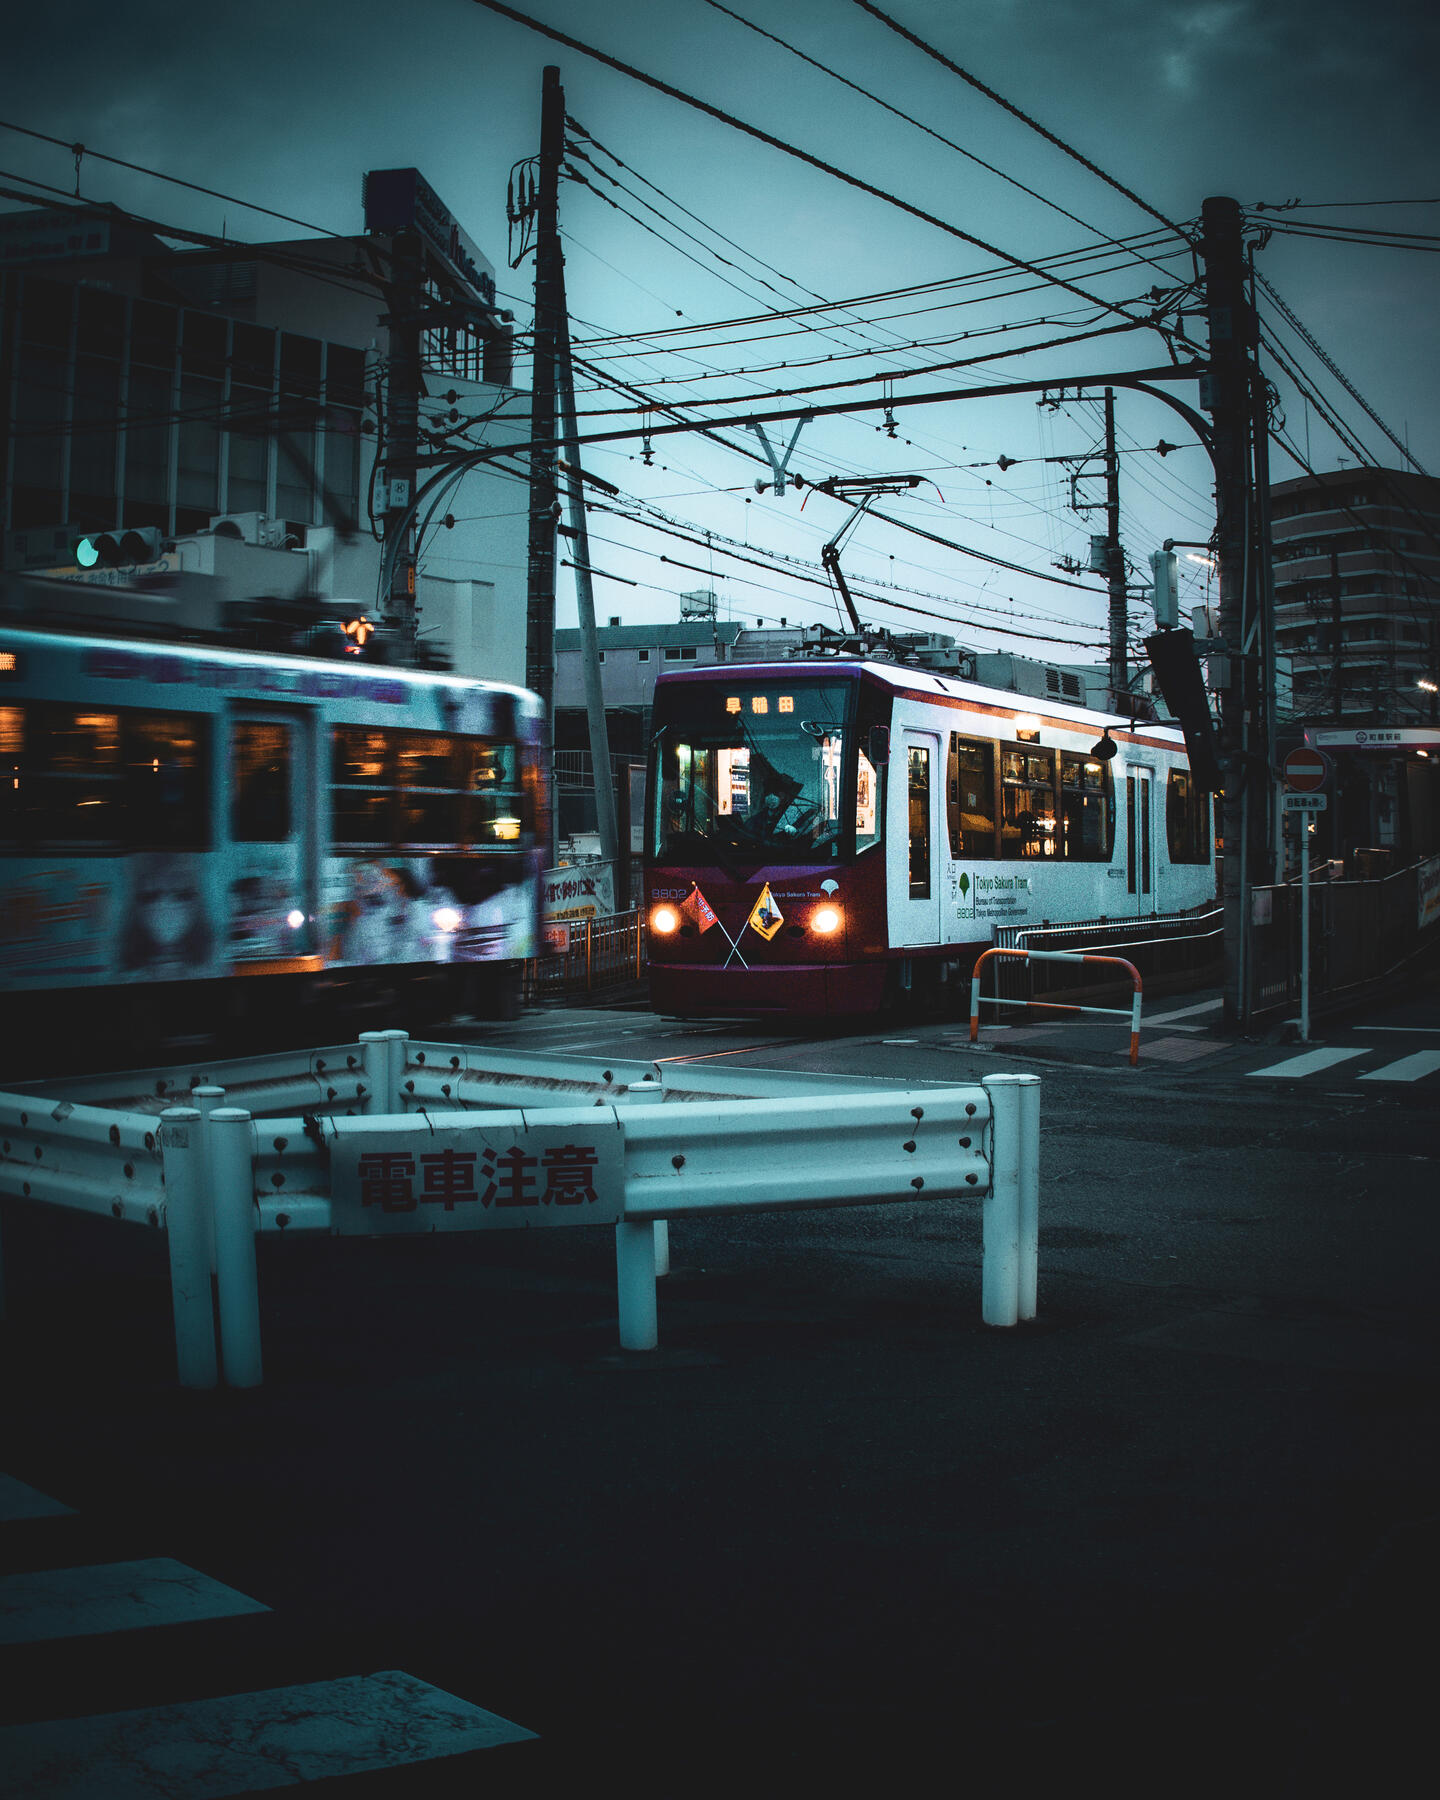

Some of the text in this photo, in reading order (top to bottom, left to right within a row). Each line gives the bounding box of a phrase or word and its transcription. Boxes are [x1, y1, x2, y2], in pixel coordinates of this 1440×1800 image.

[726, 696, 794, 714] 早稲田
[976, 875, 1027, 893] Tokyo Sakura Tram
[651, 888, 687, 899] 8802
[358, 1145, 599, 1213] 電車注意
